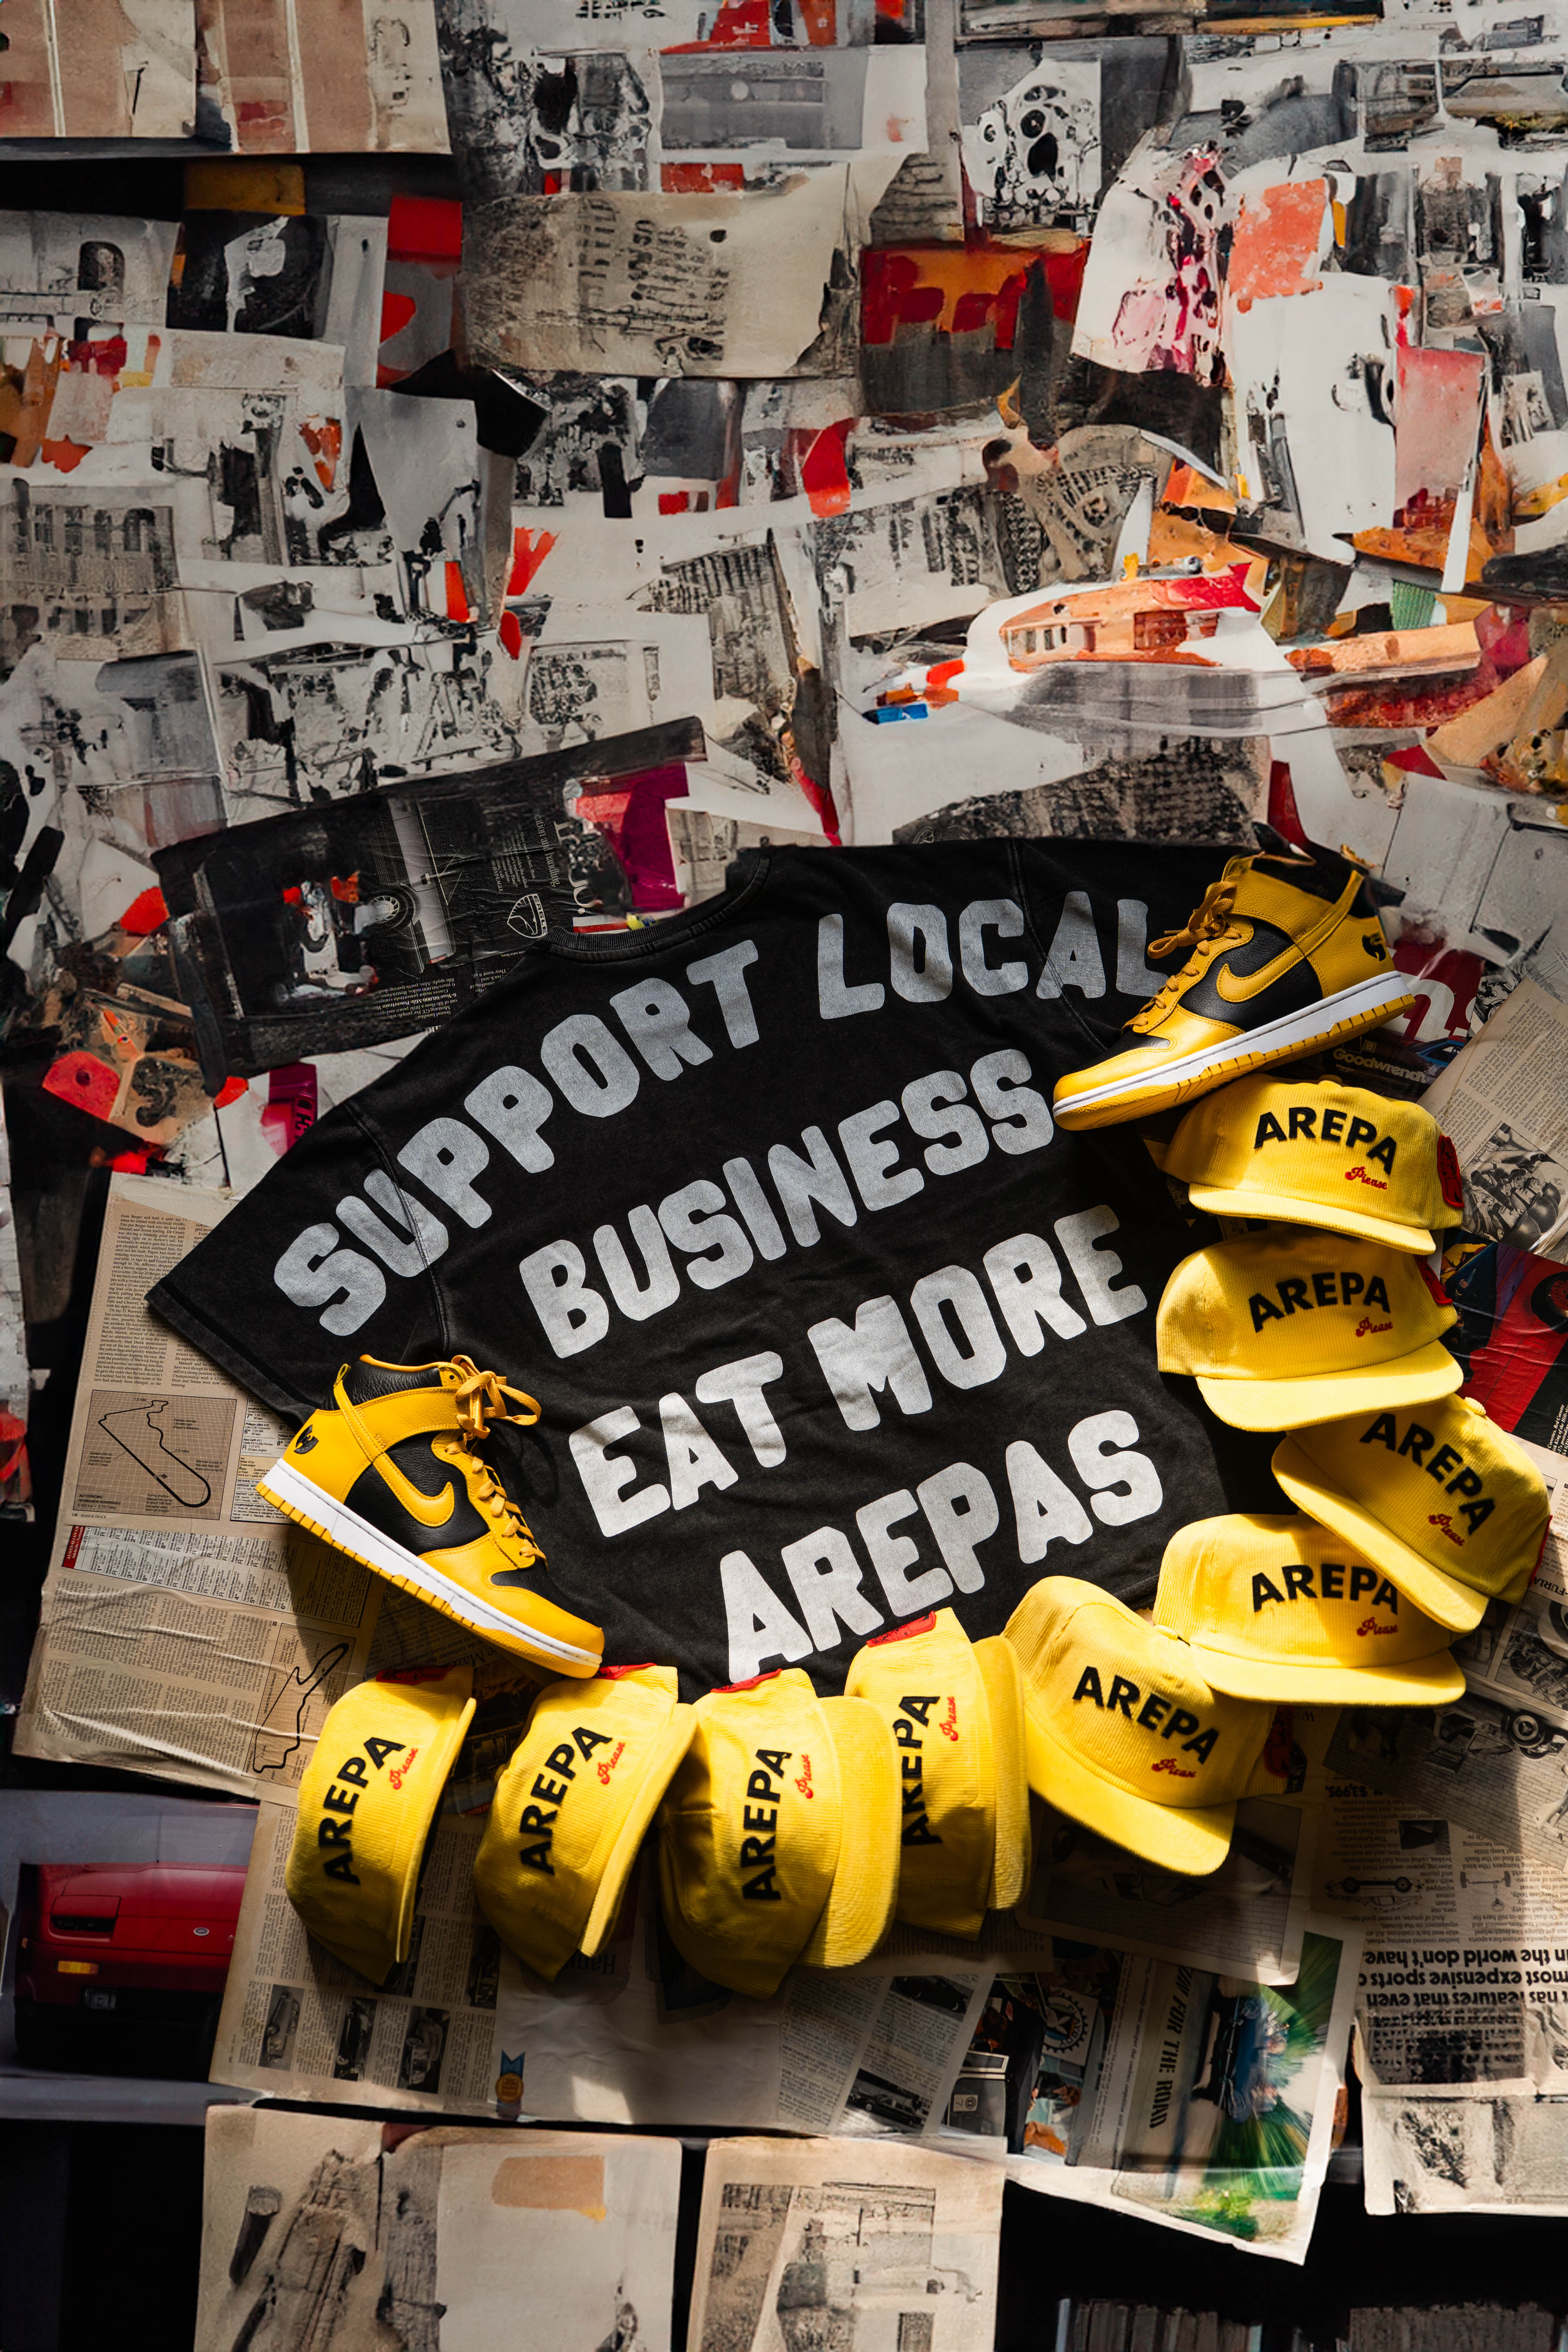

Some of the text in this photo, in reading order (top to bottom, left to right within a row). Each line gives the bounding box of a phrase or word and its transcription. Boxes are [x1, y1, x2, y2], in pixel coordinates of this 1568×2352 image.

[541, 838, 551, 851] and
[545, 853, 561, 887] handling.
[534, 896, 546, 935] EAGLE
[382, 1001, 410, 1009] Powertrain
[1543, 1018, 1551, 1028] When
[1523, 1031, 1539, 1051] Argentinians
[1508, 1055, 1519, 1067] planned
[274, 891, 1170, 1336] SUPPORT LOCAL
[1254, 1107, 1397, 1175] AREPA
[1345, 1166, 1387, 1190] Please
[519, 1049, 1054, 1359] BUSINESS
[1248, 1272, 1390, 1332] AREPA
[1355, 1317, 1393, 1337] Please
[568, 1204, 1148, 1538] EAT MORE
[1556, 1404, 1564, 1420] Corvette
[1360, 1413, 1495, 1536] AREPA
[80, 1530, 90, 1551] STARTING
[1429, 1514, 1465, 1546] Please
[67, 1532, 77, 1559] AUSTRALIAN
[719, 1409, 1163, 1683] AREPAS
[1252, 1563, 1398, 1615] AREPA
[1357, 1617, 1398, 1636] Please
[940, 1696, 958, 1741] Please
[1072, 1666, 1219, 1764] AREPA
[390, 1748, 418, 1790] Please
[598, 1742, 625, 1784] Please
[795, 1753, 813, 1798] Please
[1151, 1758, 1196, 1779] Please
[519, 1727, 613, 1875] AREPA
[1325, 1782, 1368, 1798] $3,995.
[319, 1737, 406, 1885] AREPA
[740, 1749, 792, 1900] AREPA
[1412, 1950, 1459, 1969] don't
[1463, 1949, 1518, 1968] world
[1520, 1949, 1550, 1966] the
[1370, 1967, 1568, 1990] most expensive sports
[1366, 1993, 1410, 2006] even
[1413, 1992, 1449, 2007] that
[1529, 1991, 1557, 2005] has
[1149, 1995, 1187, 2129] FOR THE ROAD
